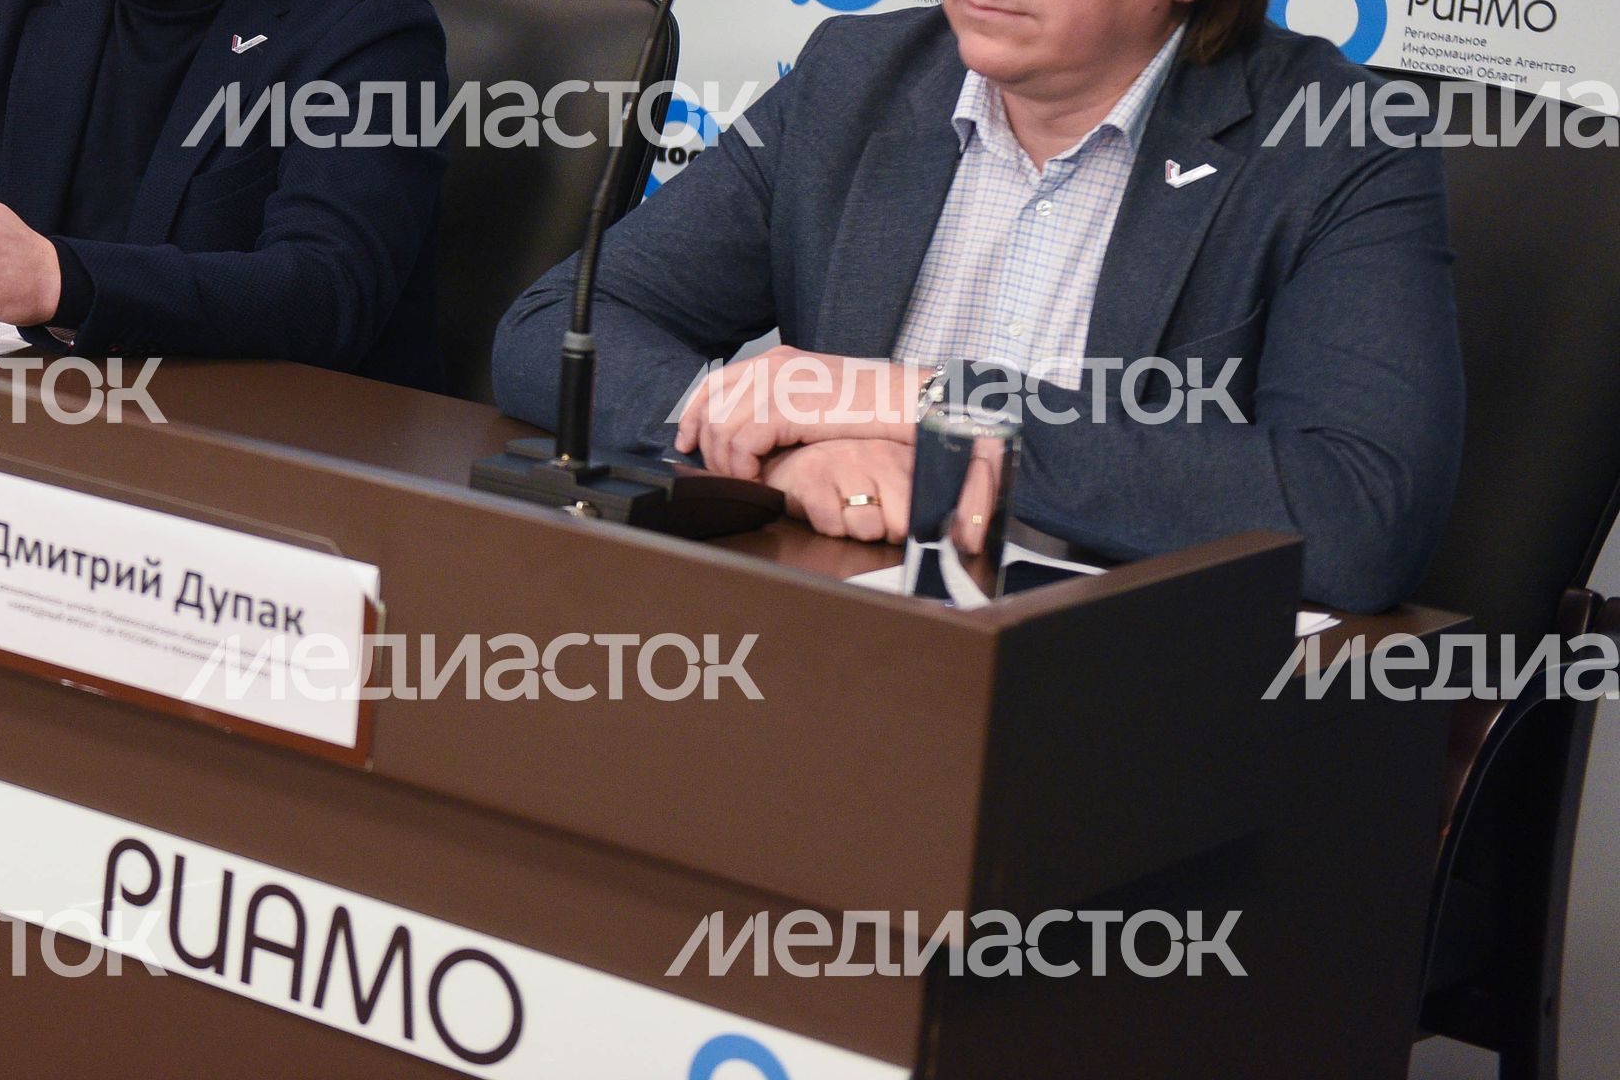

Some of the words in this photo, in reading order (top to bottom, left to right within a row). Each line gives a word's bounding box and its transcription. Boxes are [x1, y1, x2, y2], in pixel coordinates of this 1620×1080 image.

[1404, 26, 1488, 47] Региональное
[1400, 56, 1473, 77] Московской
[1476, 66, 1528, 85] Области
[1402, 41, 1513, 67] Информационное
[1515, 56, 1577, 74] Агентство
[174, 570, 305, 636] Дупак
